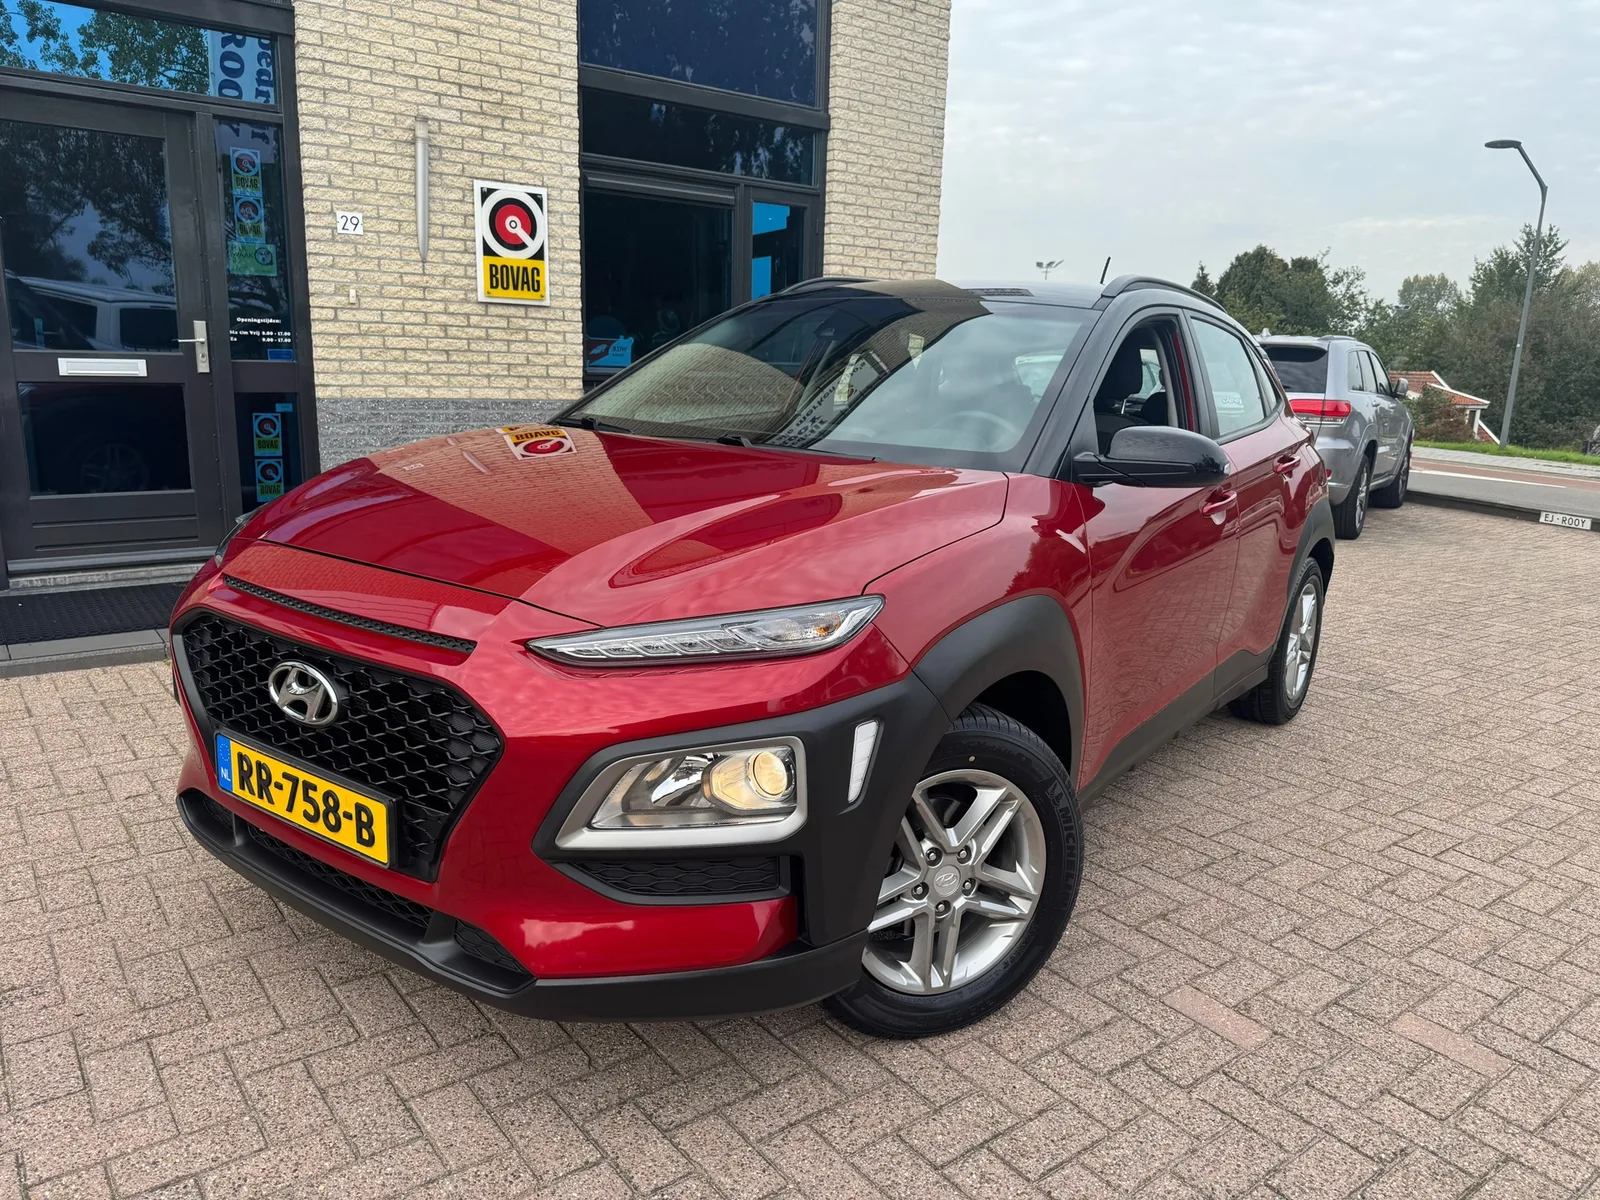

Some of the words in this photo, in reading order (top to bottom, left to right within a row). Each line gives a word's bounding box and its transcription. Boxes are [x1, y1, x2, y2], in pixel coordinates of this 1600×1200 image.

[235, 176, 259, 189] BOVAG
[339, 214, 360, 232] 29
[488, 263, 541, 293] BOVAG
[236, 316, 282, 324] Openingstijden:
[257, 438, 279, 450] BOVAG
[259, 483, 281, 495] BOVAG
[1544, 513, 1555, 523] EJ
[1562, 516, 1586, 527] ROOY
[220, 765, 231, 782] NL
[236, 751, 376, 848] RR-758-B
